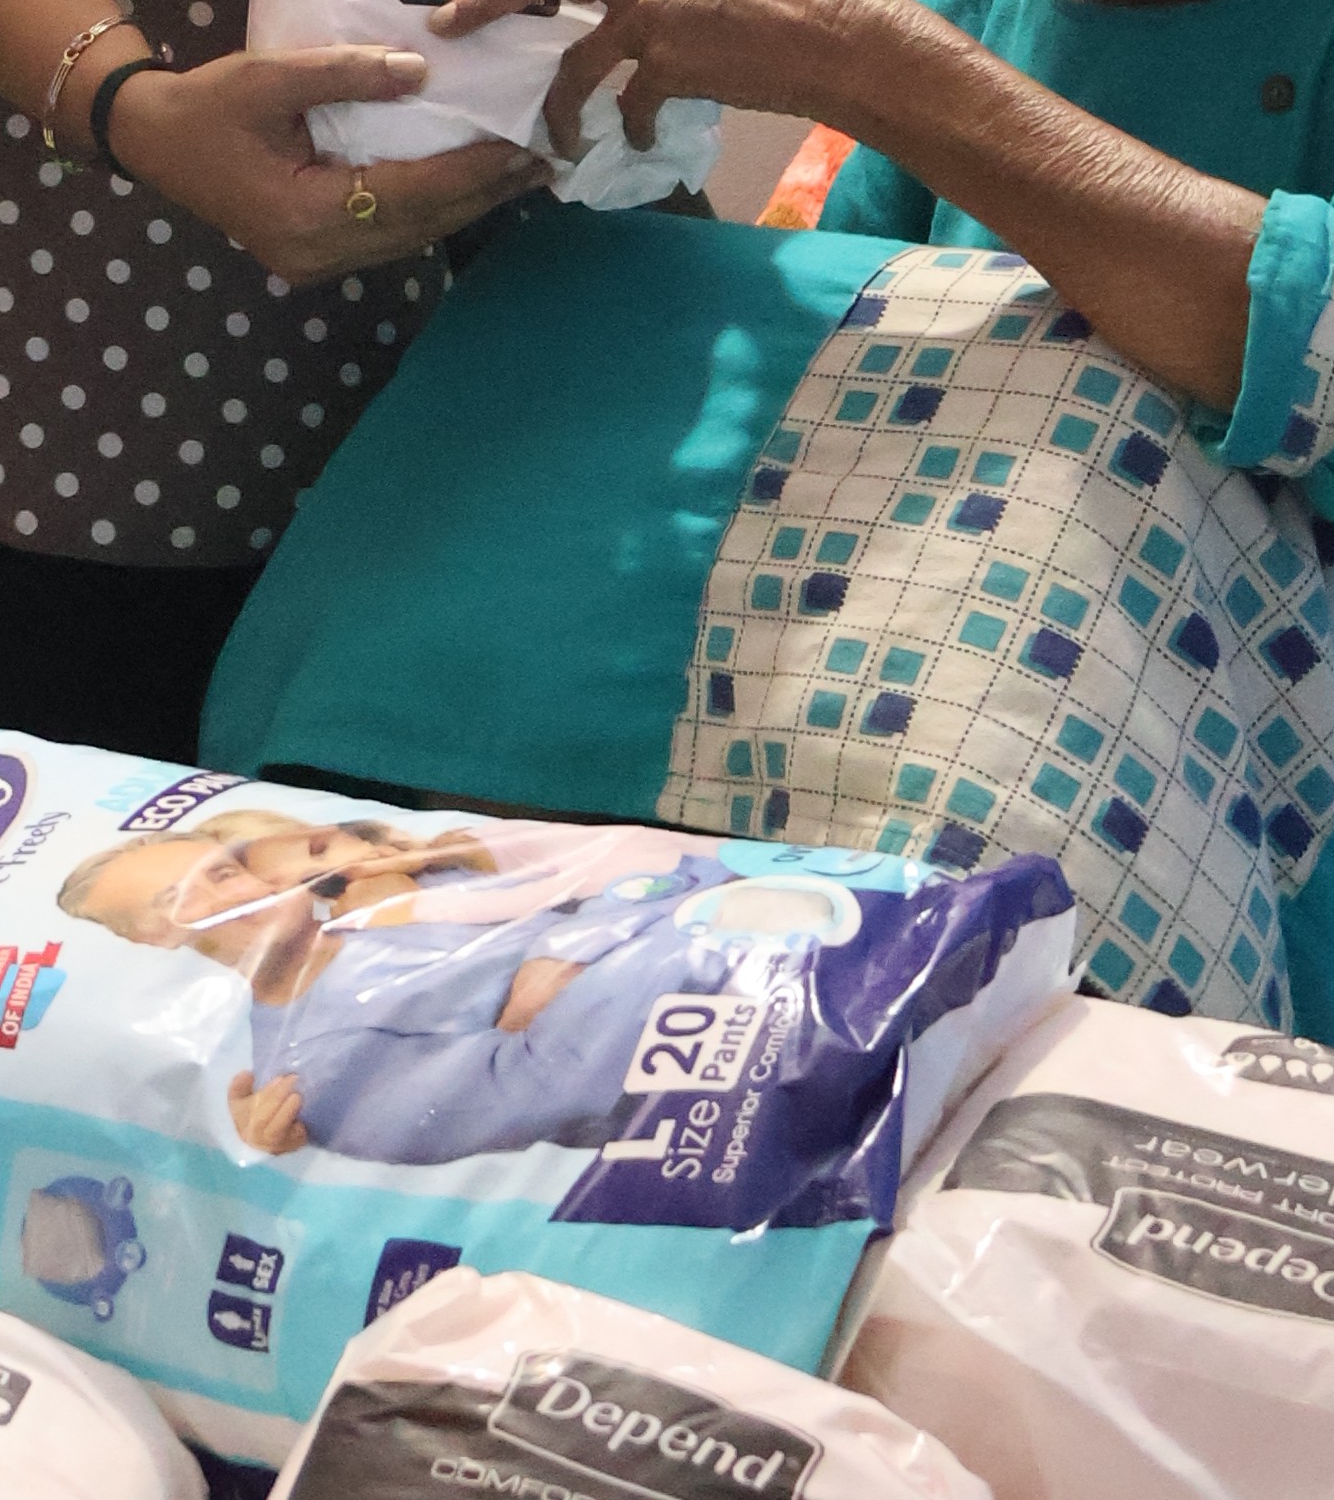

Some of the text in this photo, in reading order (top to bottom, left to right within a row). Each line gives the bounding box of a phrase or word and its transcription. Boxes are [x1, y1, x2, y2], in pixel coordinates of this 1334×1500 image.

[128, 794, 198, 830] ECO
[2, 962, 40, 1036] OF INDIA
[602, 1005, 716, 1160] L 20
[661, 1004, 757, 1180] Size Pants
[712, 1088, 762, 1184] Superior
[536, 1376, 785, 1492] Depend
